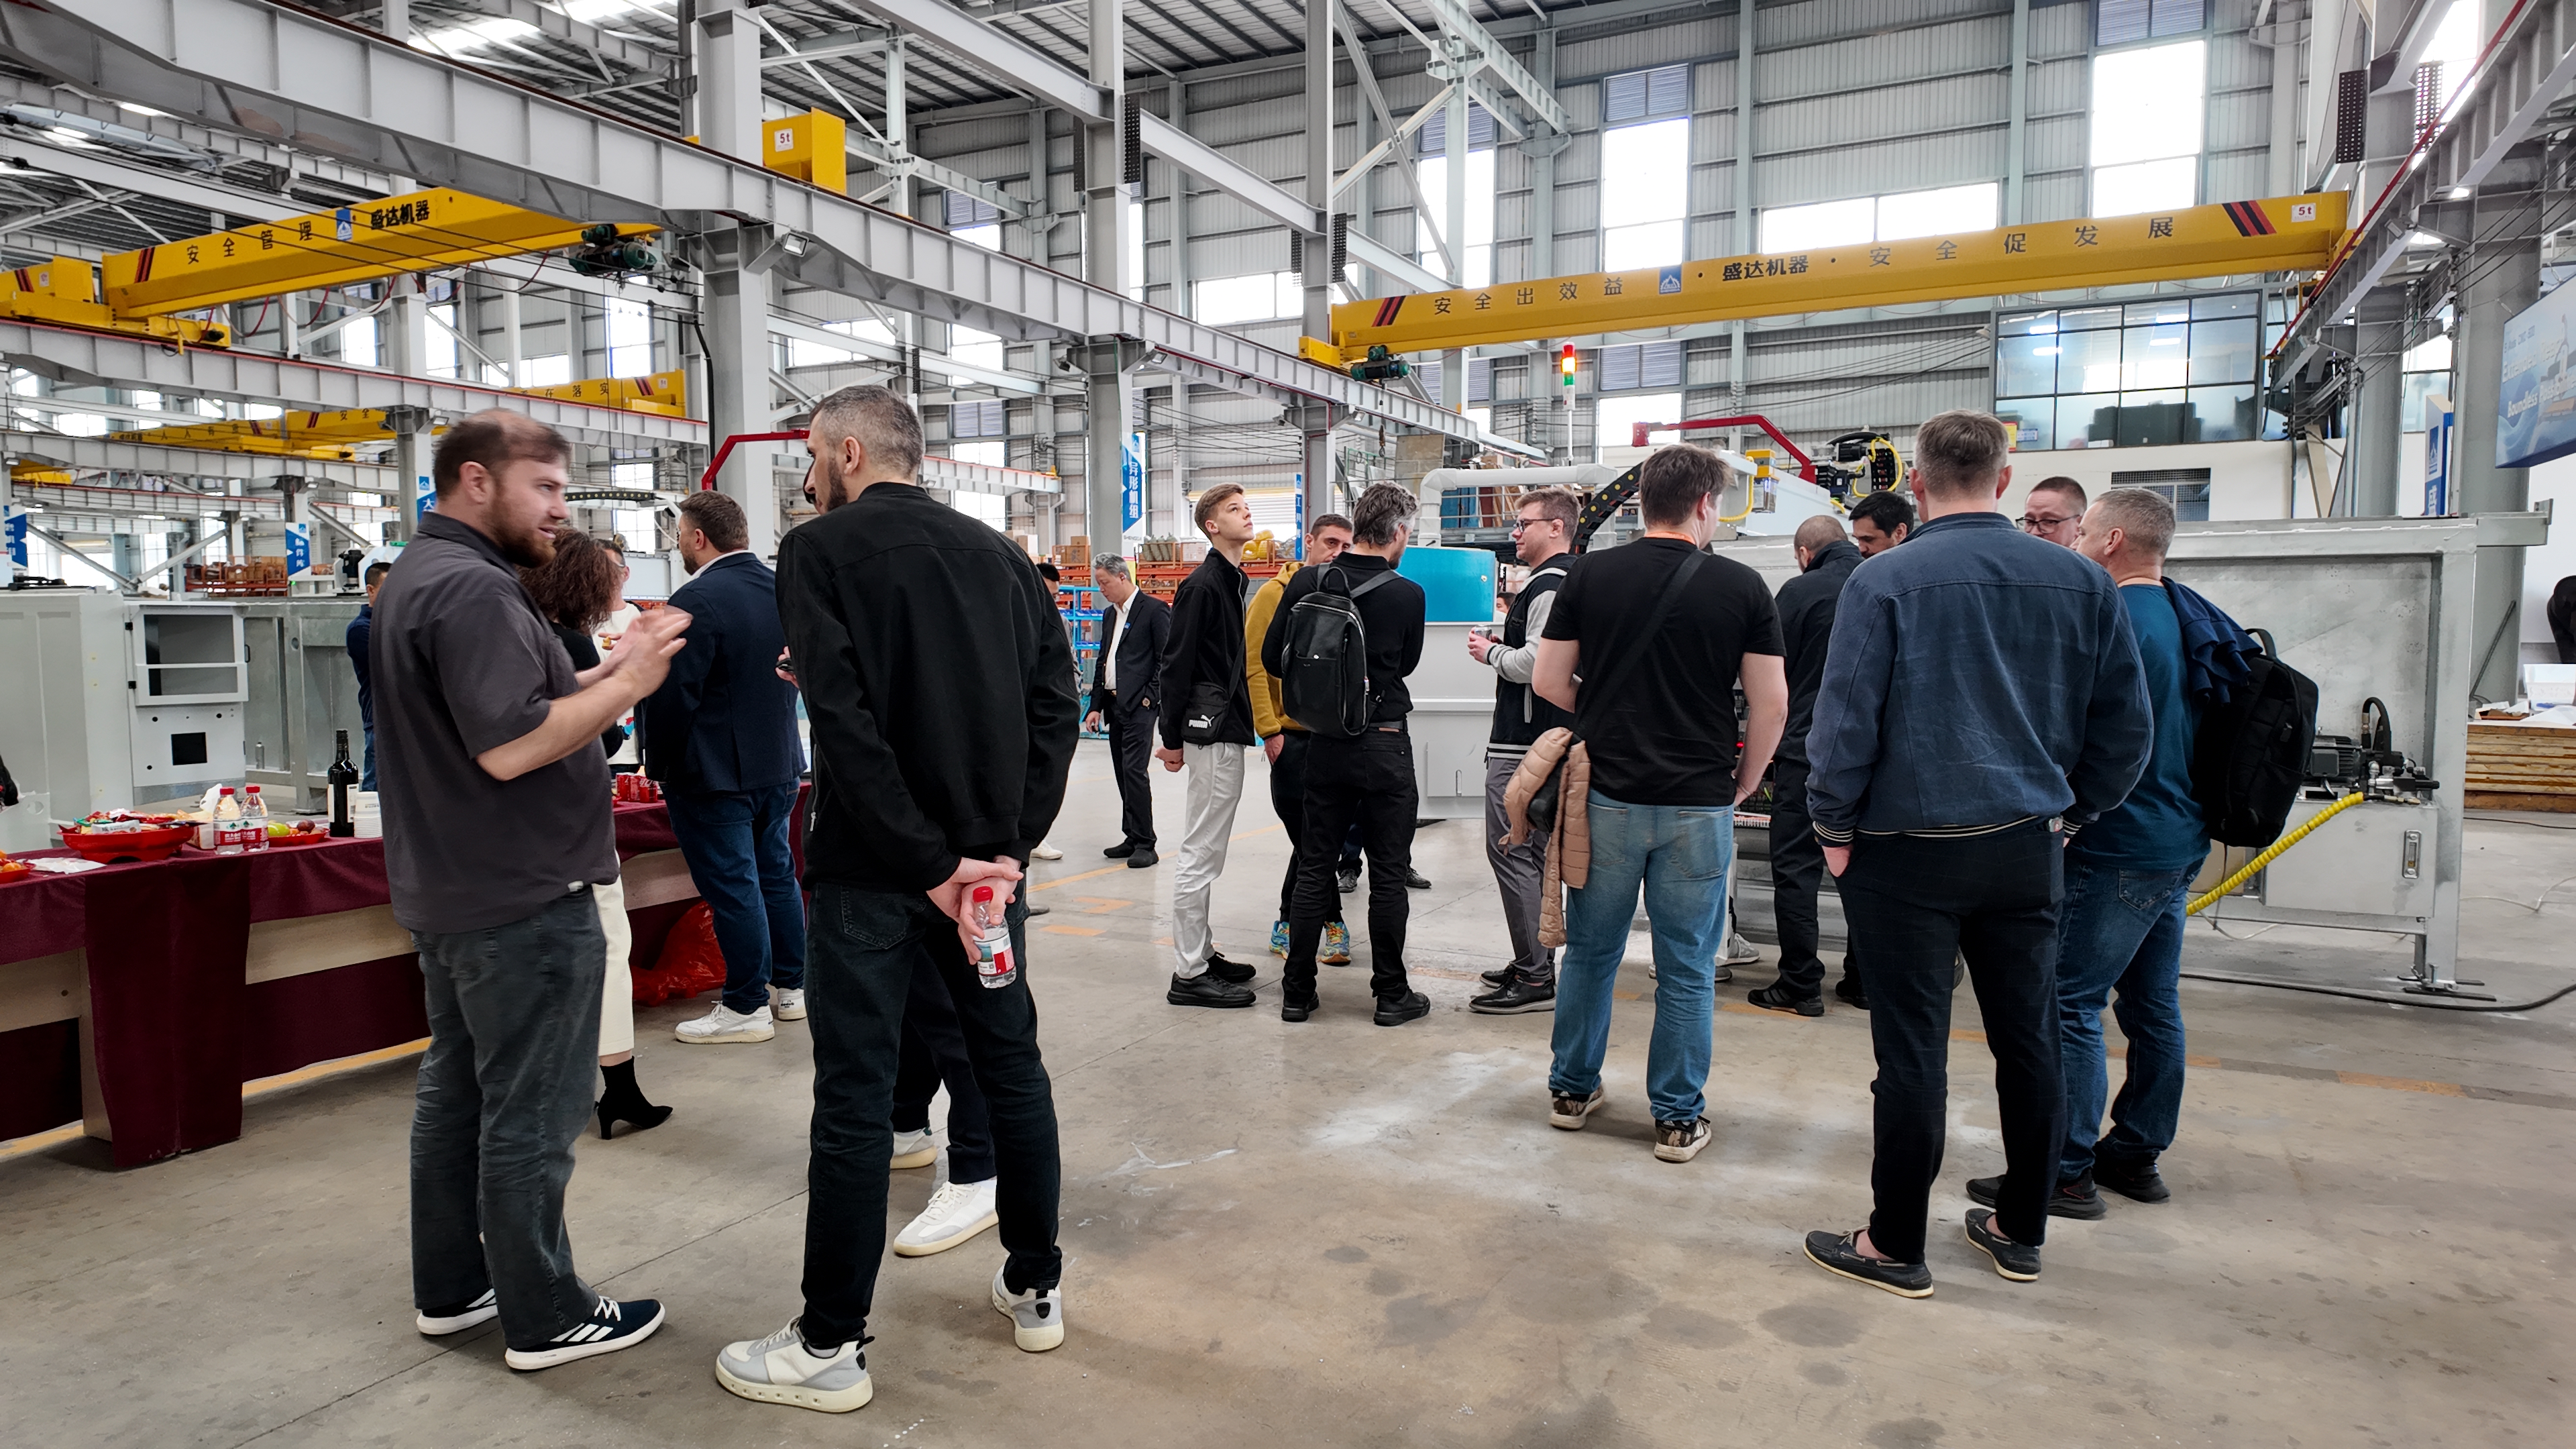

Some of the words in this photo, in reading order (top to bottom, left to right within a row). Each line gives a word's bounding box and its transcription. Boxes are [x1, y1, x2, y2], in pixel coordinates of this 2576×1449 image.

[780, 133, 790, 144] 5t
[2298, 206, 2312, 215] 5t
[186, 220, 313, 265] 安全管理
[370, 199, 430, 230] 盛达机器
[1434, 276, 1623, 315] 安全出效益
[1722, 254, 1809, 282] 盛达机器
[1869, 216, 2174, 268] 安全促发展
[1129, 461, 1139, 519] 异形机组
[1188, 719, 1208, 729] PUMA
